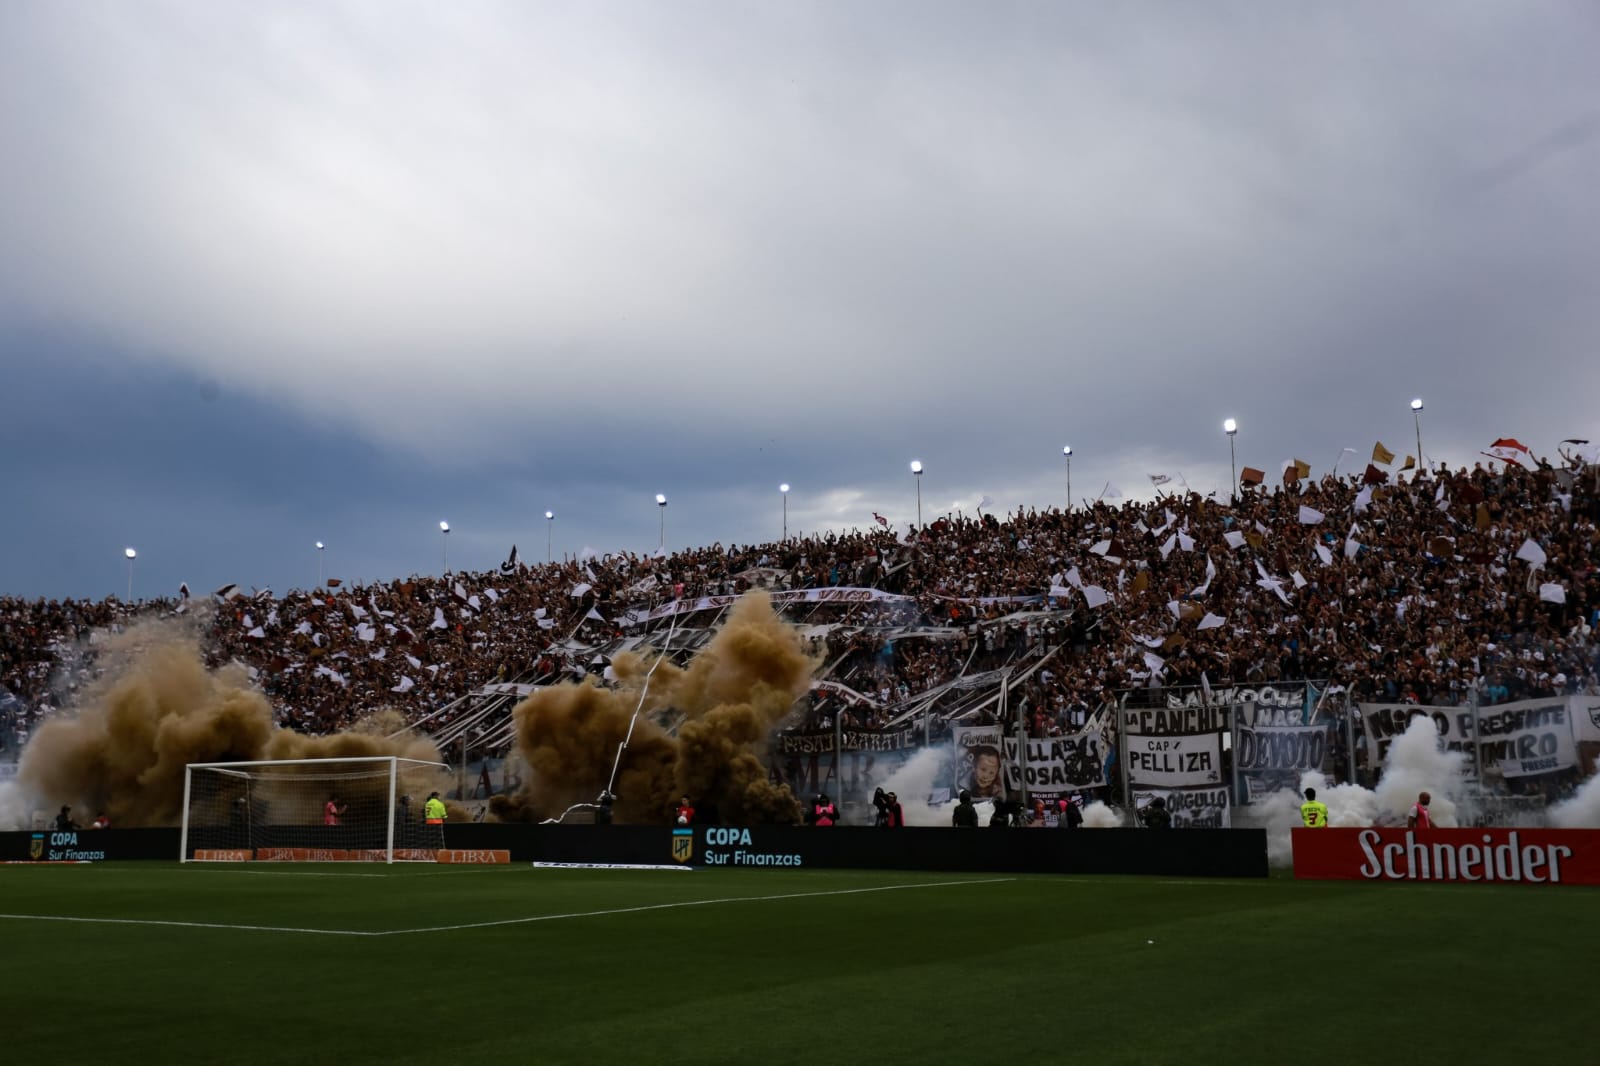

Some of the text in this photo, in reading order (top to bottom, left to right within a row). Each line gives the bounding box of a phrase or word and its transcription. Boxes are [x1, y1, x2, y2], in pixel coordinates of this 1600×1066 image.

[1006, 742, 1064, 762] VLLA
[1130, 752, 1211, 772] PELLIZA
[51, 832, 78, 846] COPA
[706, 828, 752, 846] COPA
[49, 849, 63, 860] Sur
[65, 849, 105, 860] Finanzas
[202, 850, 245, 861] LIBRA
[450, 851, 497, 862] LIBRA
[705, 850, 802, 867] Sur Finanzas
[1358, 830, 1571, 882] Schneider
